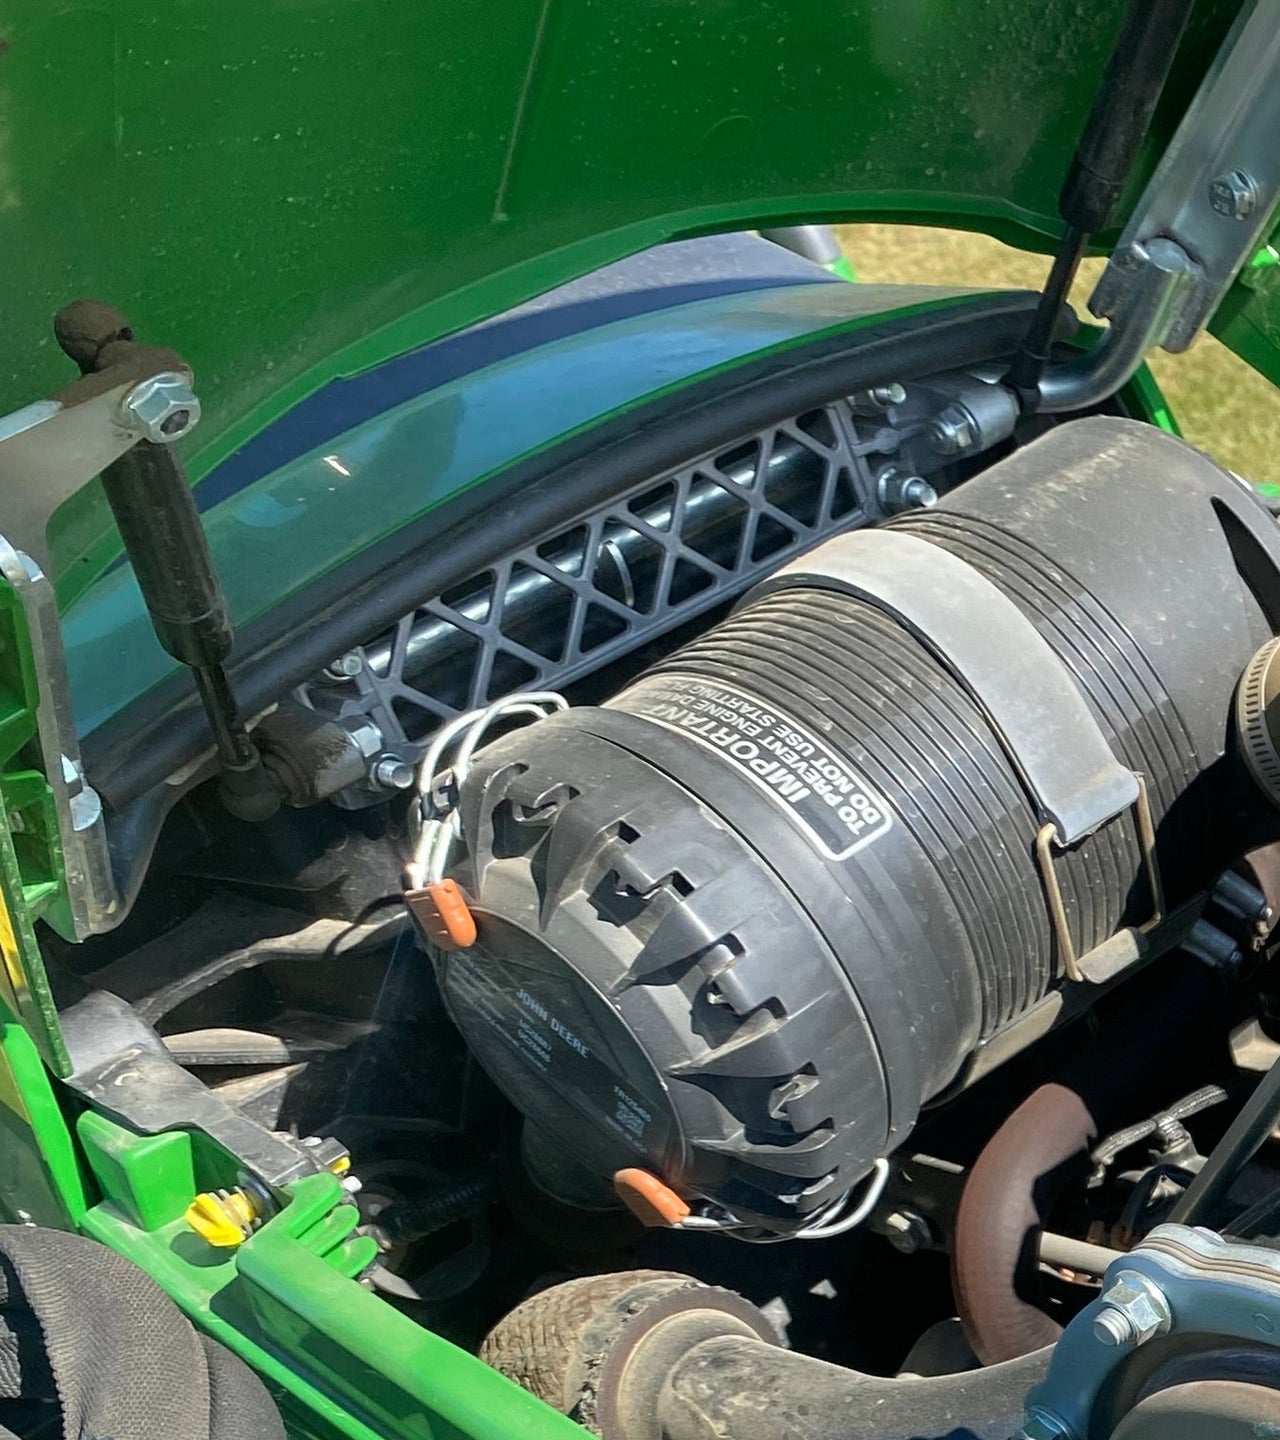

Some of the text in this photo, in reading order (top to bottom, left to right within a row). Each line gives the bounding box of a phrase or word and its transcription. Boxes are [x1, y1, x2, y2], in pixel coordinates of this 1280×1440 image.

[641, 704, 812, 803] IMPORTANT
[693, 701, 761, 737] ENGINE
[695, 686, 881, 825] DO NOT USE STARTING
[758, 736, 844, 806] PREVENT
[838, 806, 866, 836] TO
[517, 989, 549, 1021] JOHN
[551, 1018, 592, 1059] DEERE
